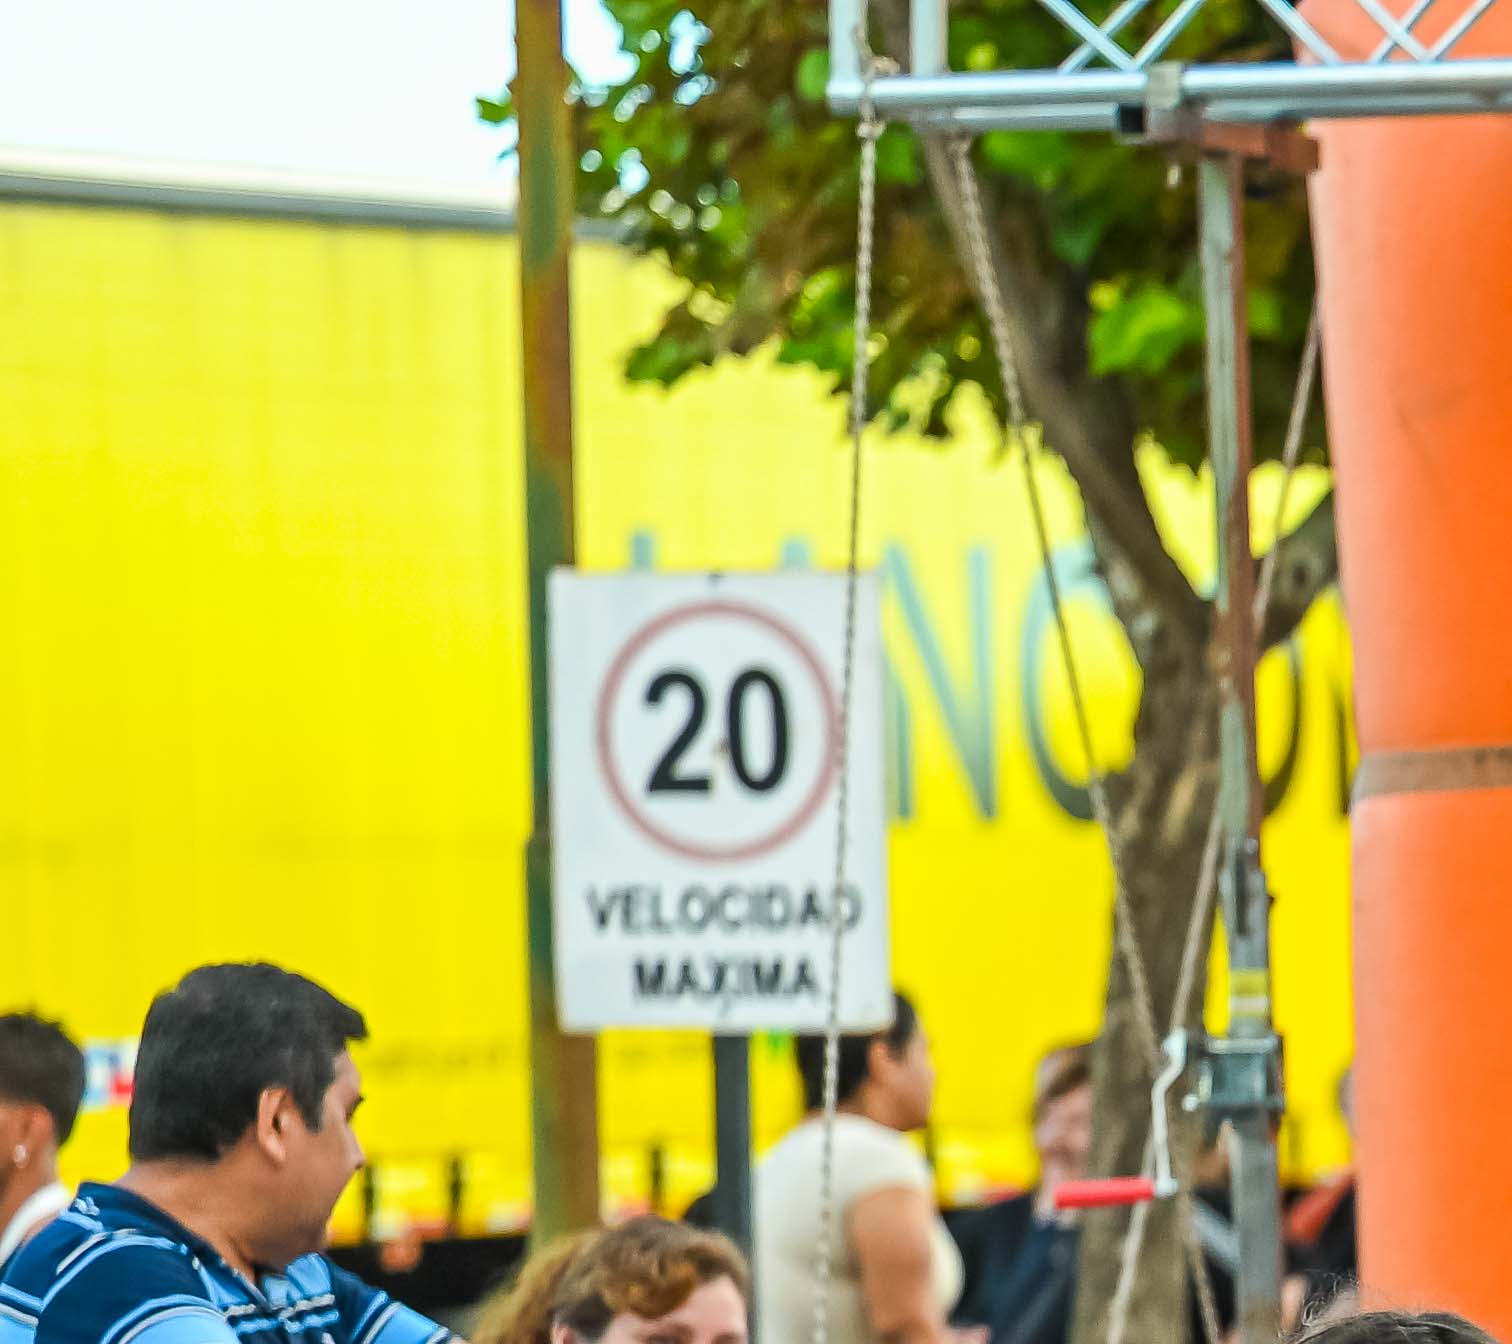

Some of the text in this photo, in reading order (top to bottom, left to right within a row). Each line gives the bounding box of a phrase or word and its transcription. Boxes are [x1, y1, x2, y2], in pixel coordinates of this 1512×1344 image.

[644, 667, 790, 794] 20
[586, 884, 861, 934] VELOCIDAD
[633, 956, 820, 1002] MAXIMA
